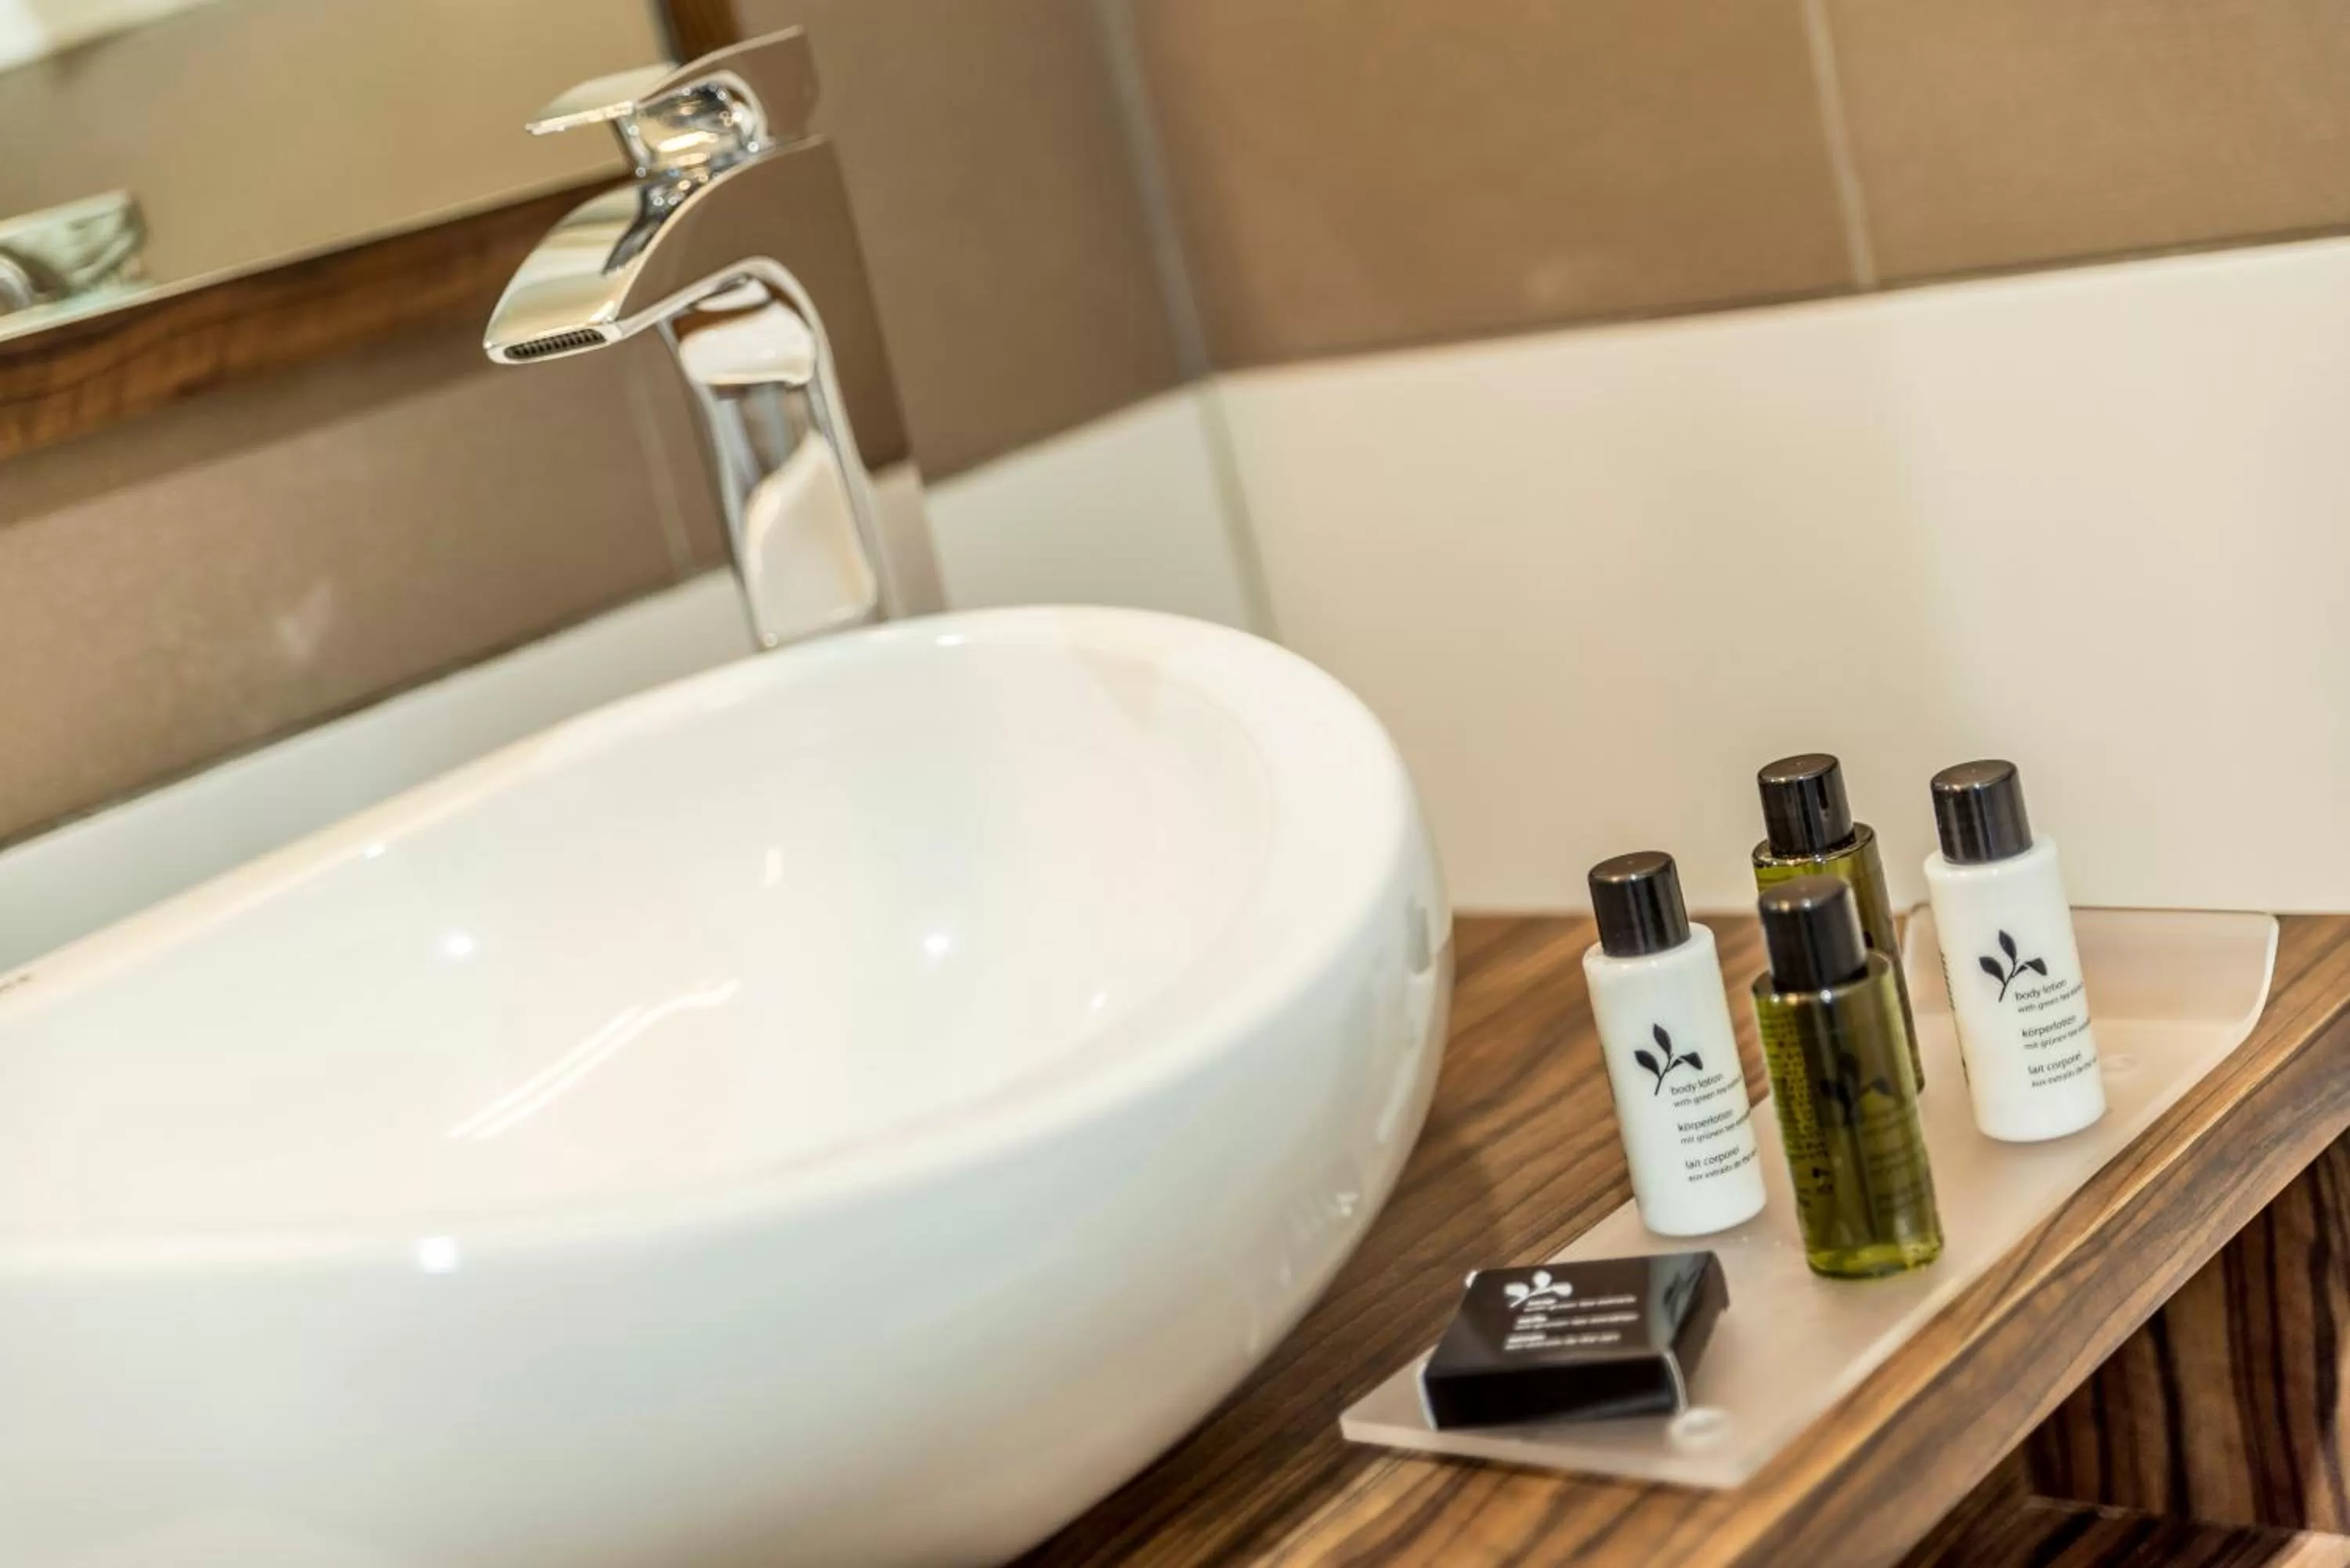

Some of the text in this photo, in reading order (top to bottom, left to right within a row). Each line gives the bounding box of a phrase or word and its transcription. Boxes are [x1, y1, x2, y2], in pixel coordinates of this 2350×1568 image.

[2015, 988, 2041, 1001] body
[2042, 979, 2067, 994] lotion
[1669, 1083, 1696, 1096] body
[1697, 1074, 1723, 1088] lotion
